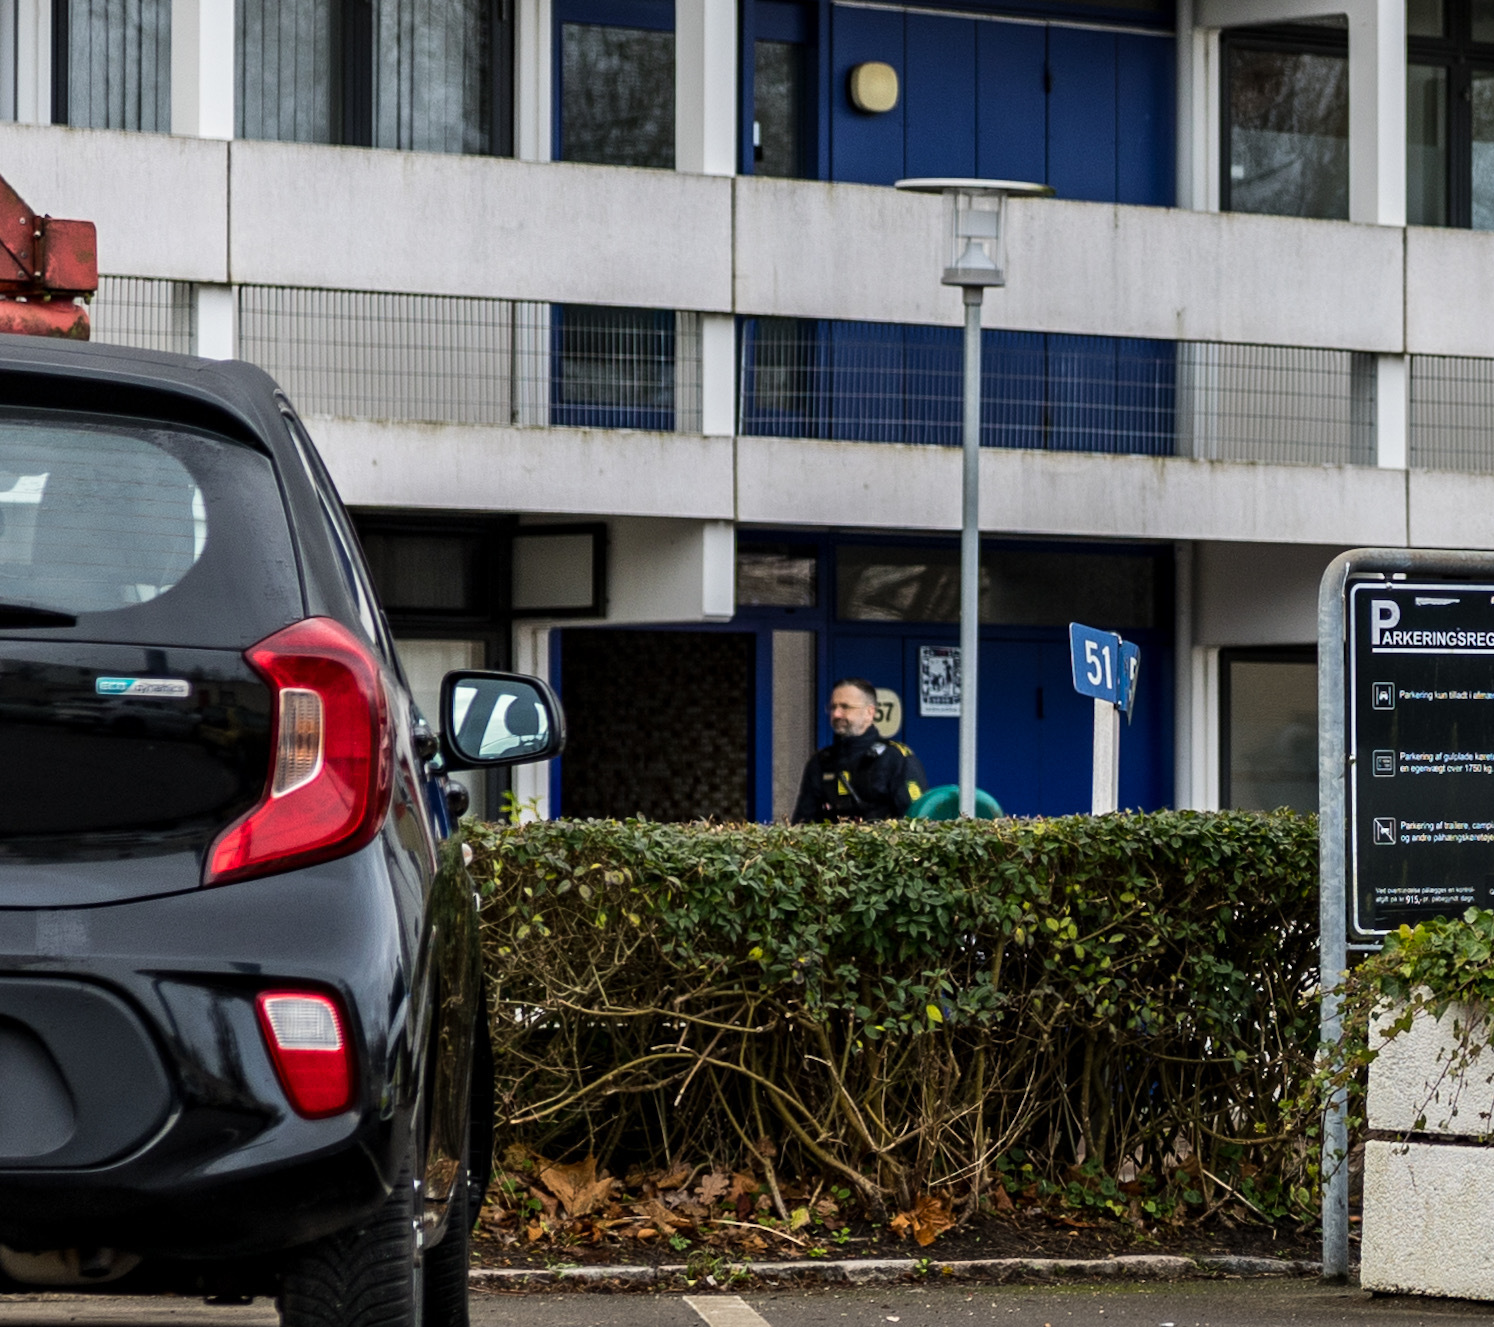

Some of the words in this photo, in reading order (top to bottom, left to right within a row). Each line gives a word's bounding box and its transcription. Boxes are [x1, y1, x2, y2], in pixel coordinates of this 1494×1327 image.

[1085, 639, 1113, 690] 51
[1399, 690, 1434, 701] Parkering
[1399, 751, 1434, 762] Parkering
[1400, 820, 1434, 832] Parkering
